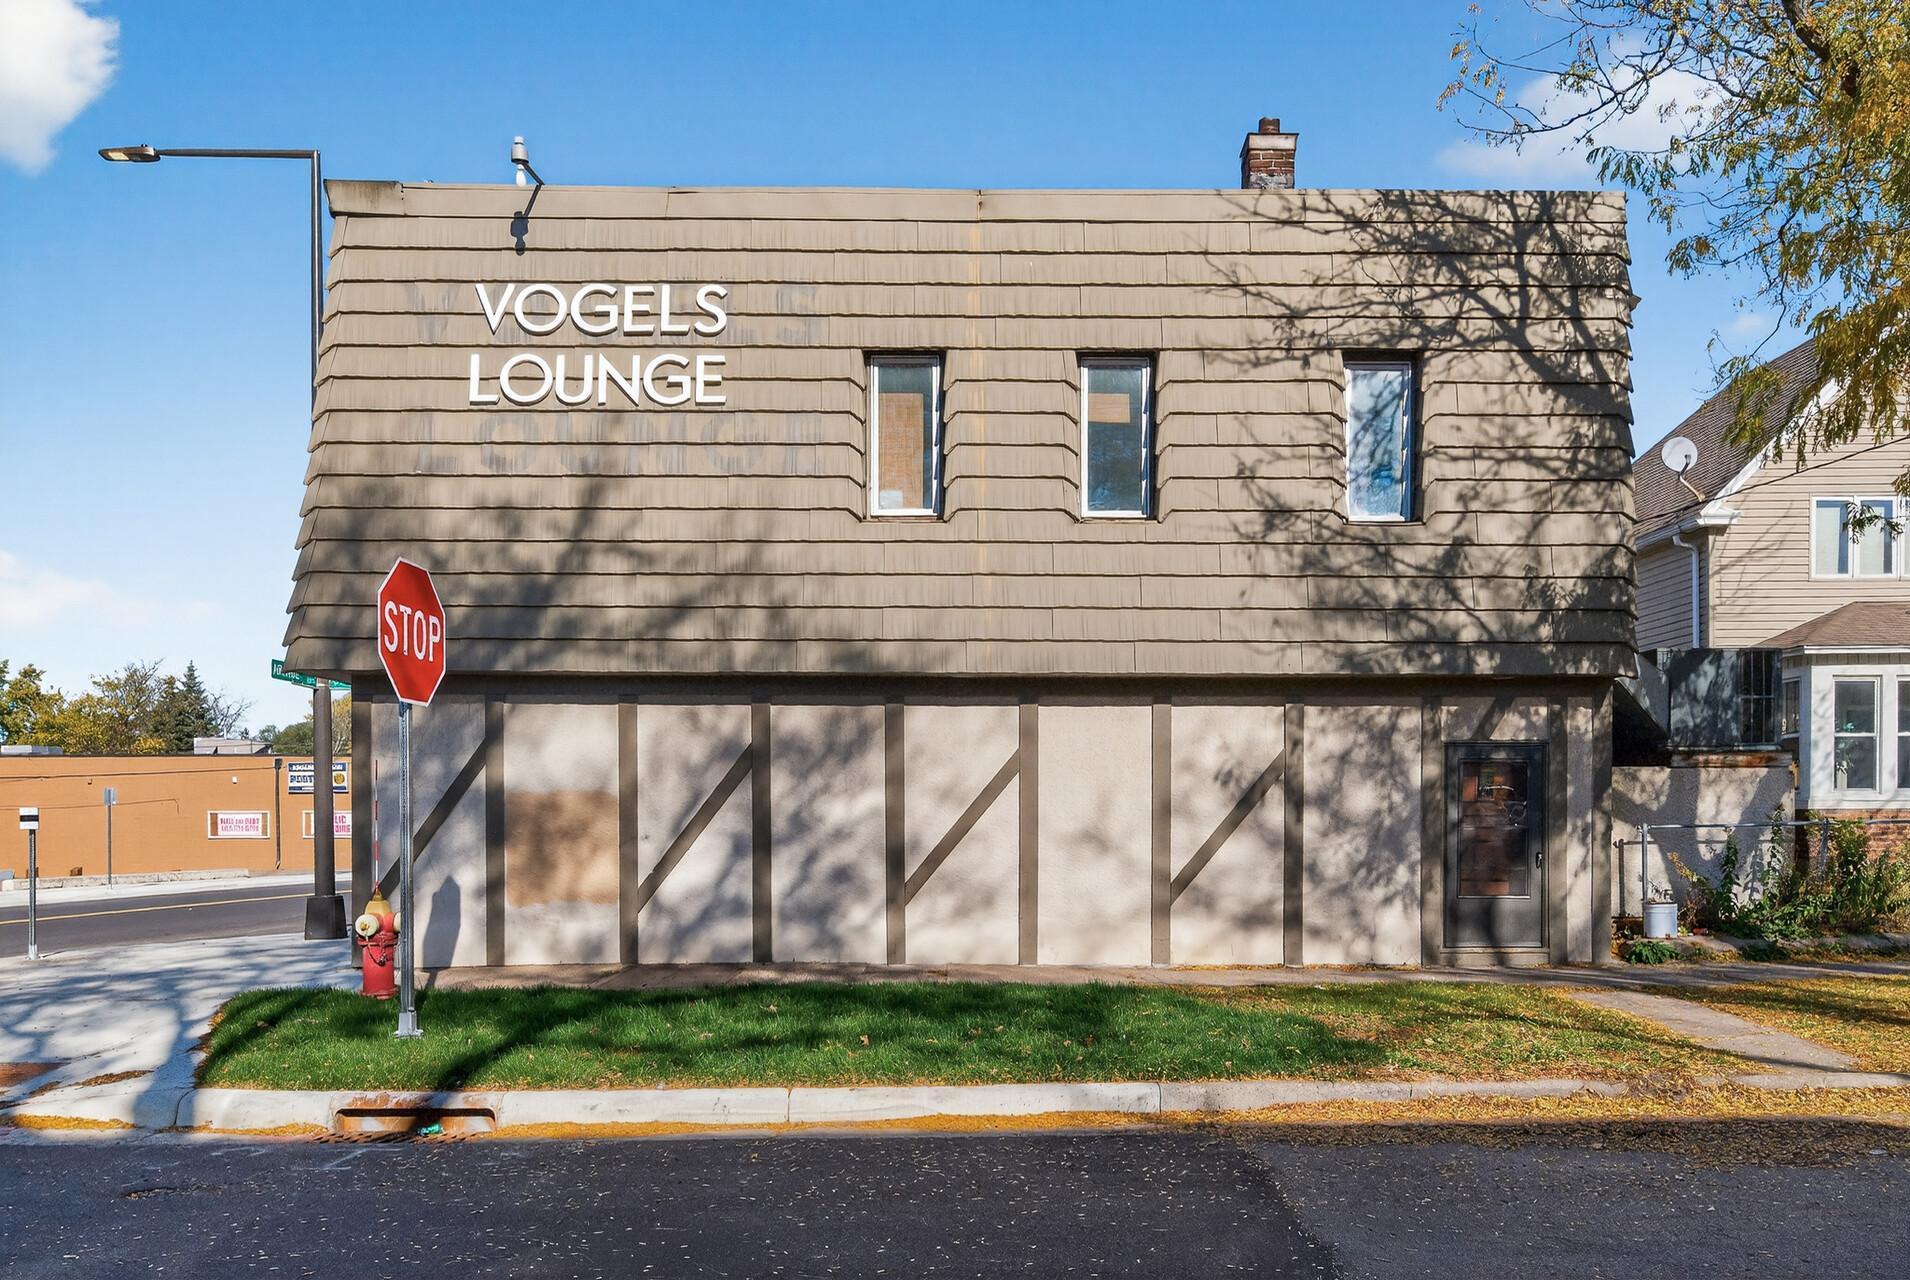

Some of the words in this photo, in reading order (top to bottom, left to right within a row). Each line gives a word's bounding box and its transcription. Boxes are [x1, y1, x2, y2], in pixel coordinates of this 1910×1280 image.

[474, 283, 729, 337] VOGELS
[468, 352, 728, 407] LOUNGE
[384, 600, 441, 662] STOP
